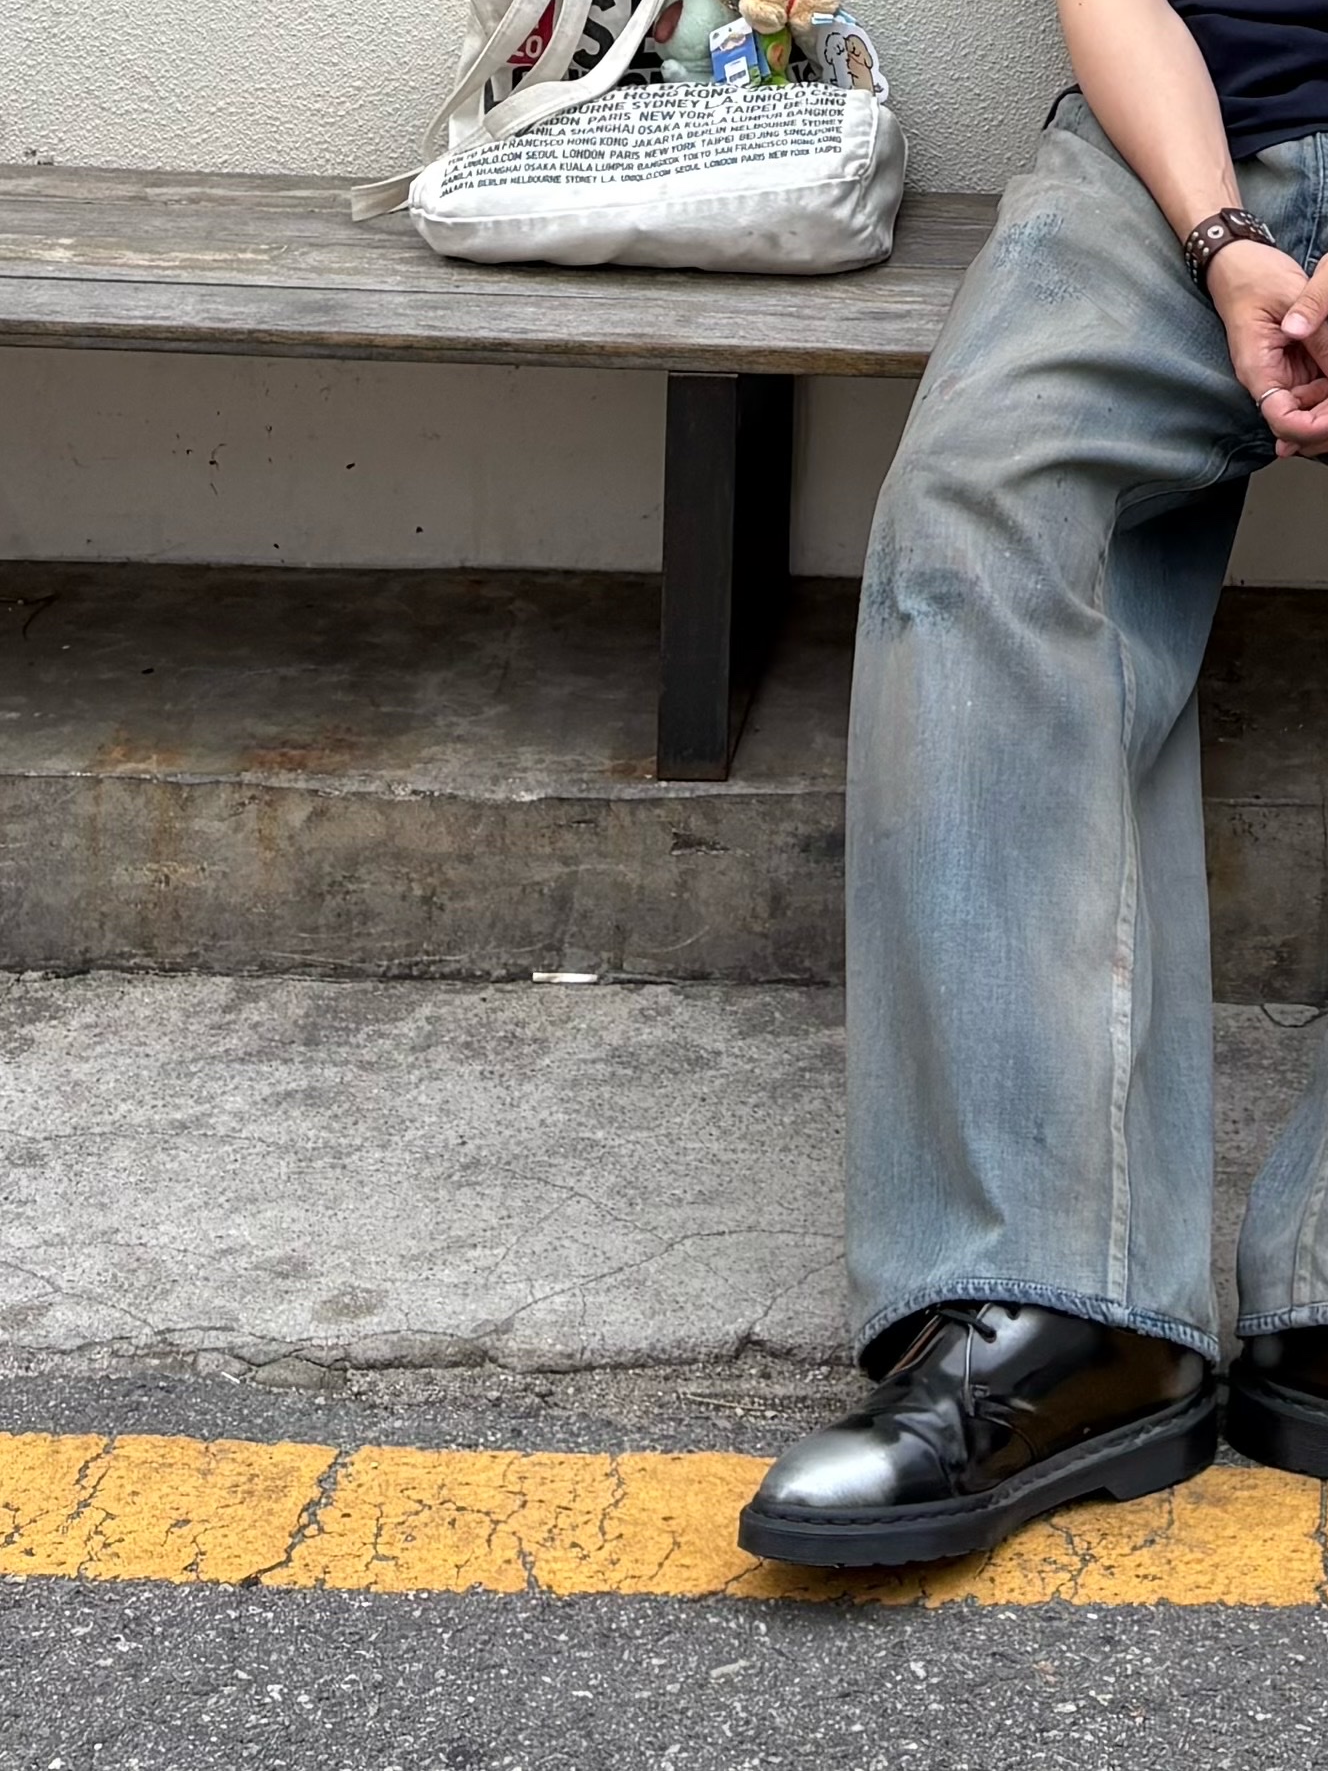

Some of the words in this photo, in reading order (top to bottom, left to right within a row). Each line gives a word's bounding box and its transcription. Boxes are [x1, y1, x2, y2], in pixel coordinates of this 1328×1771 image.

[587, 111, 633, 126] PARIS
[639, 111, 676, 122] NEW
[679, 109, 717, 121] YORK
[725, 103, 777, 115] TAIPEI
[783, 97, 847, 111] BEIJING
[632, 98, 700, 110] SYDNEY
[502, 138, 565, 151] FRANCISCO
[567, 136, 598, 147] HONG
[599, 136, 629, 148] KONG
[631, 132, 684, 149] JAKARTA
[686, 125, 728, 139] BERLIN
[730, 119, 798, 133] MELBOURNE
[801, 118, 844, 128] SYDNEY
[570, 123, 635, 136] SHANGHAI
[637, 122, 681, 135] OSAKA
[684, 116, 728, 130] KUALA
[731, 111, 783, 124] LUMPUR
[785, 107, 845, 118] BANGKOK
[524, 161, 557, 172] OSAKA
[559, 161, 594, 172] KUALA
[595, 161, 635, 173] LUMPUR
[735, 138, 789, 153] FRANCISCO
[525, 150, 559, 161] SEOUL
[561, 149, 606, 161] LONDON
[609, 149, 641, 161] PARIS
[644, 146, 671, 159] NEW
[671, 140, 697, 154] YORK
[701, 134, 735, 148] TAIPEI
[738, 130, 781, 142] BEIJING
